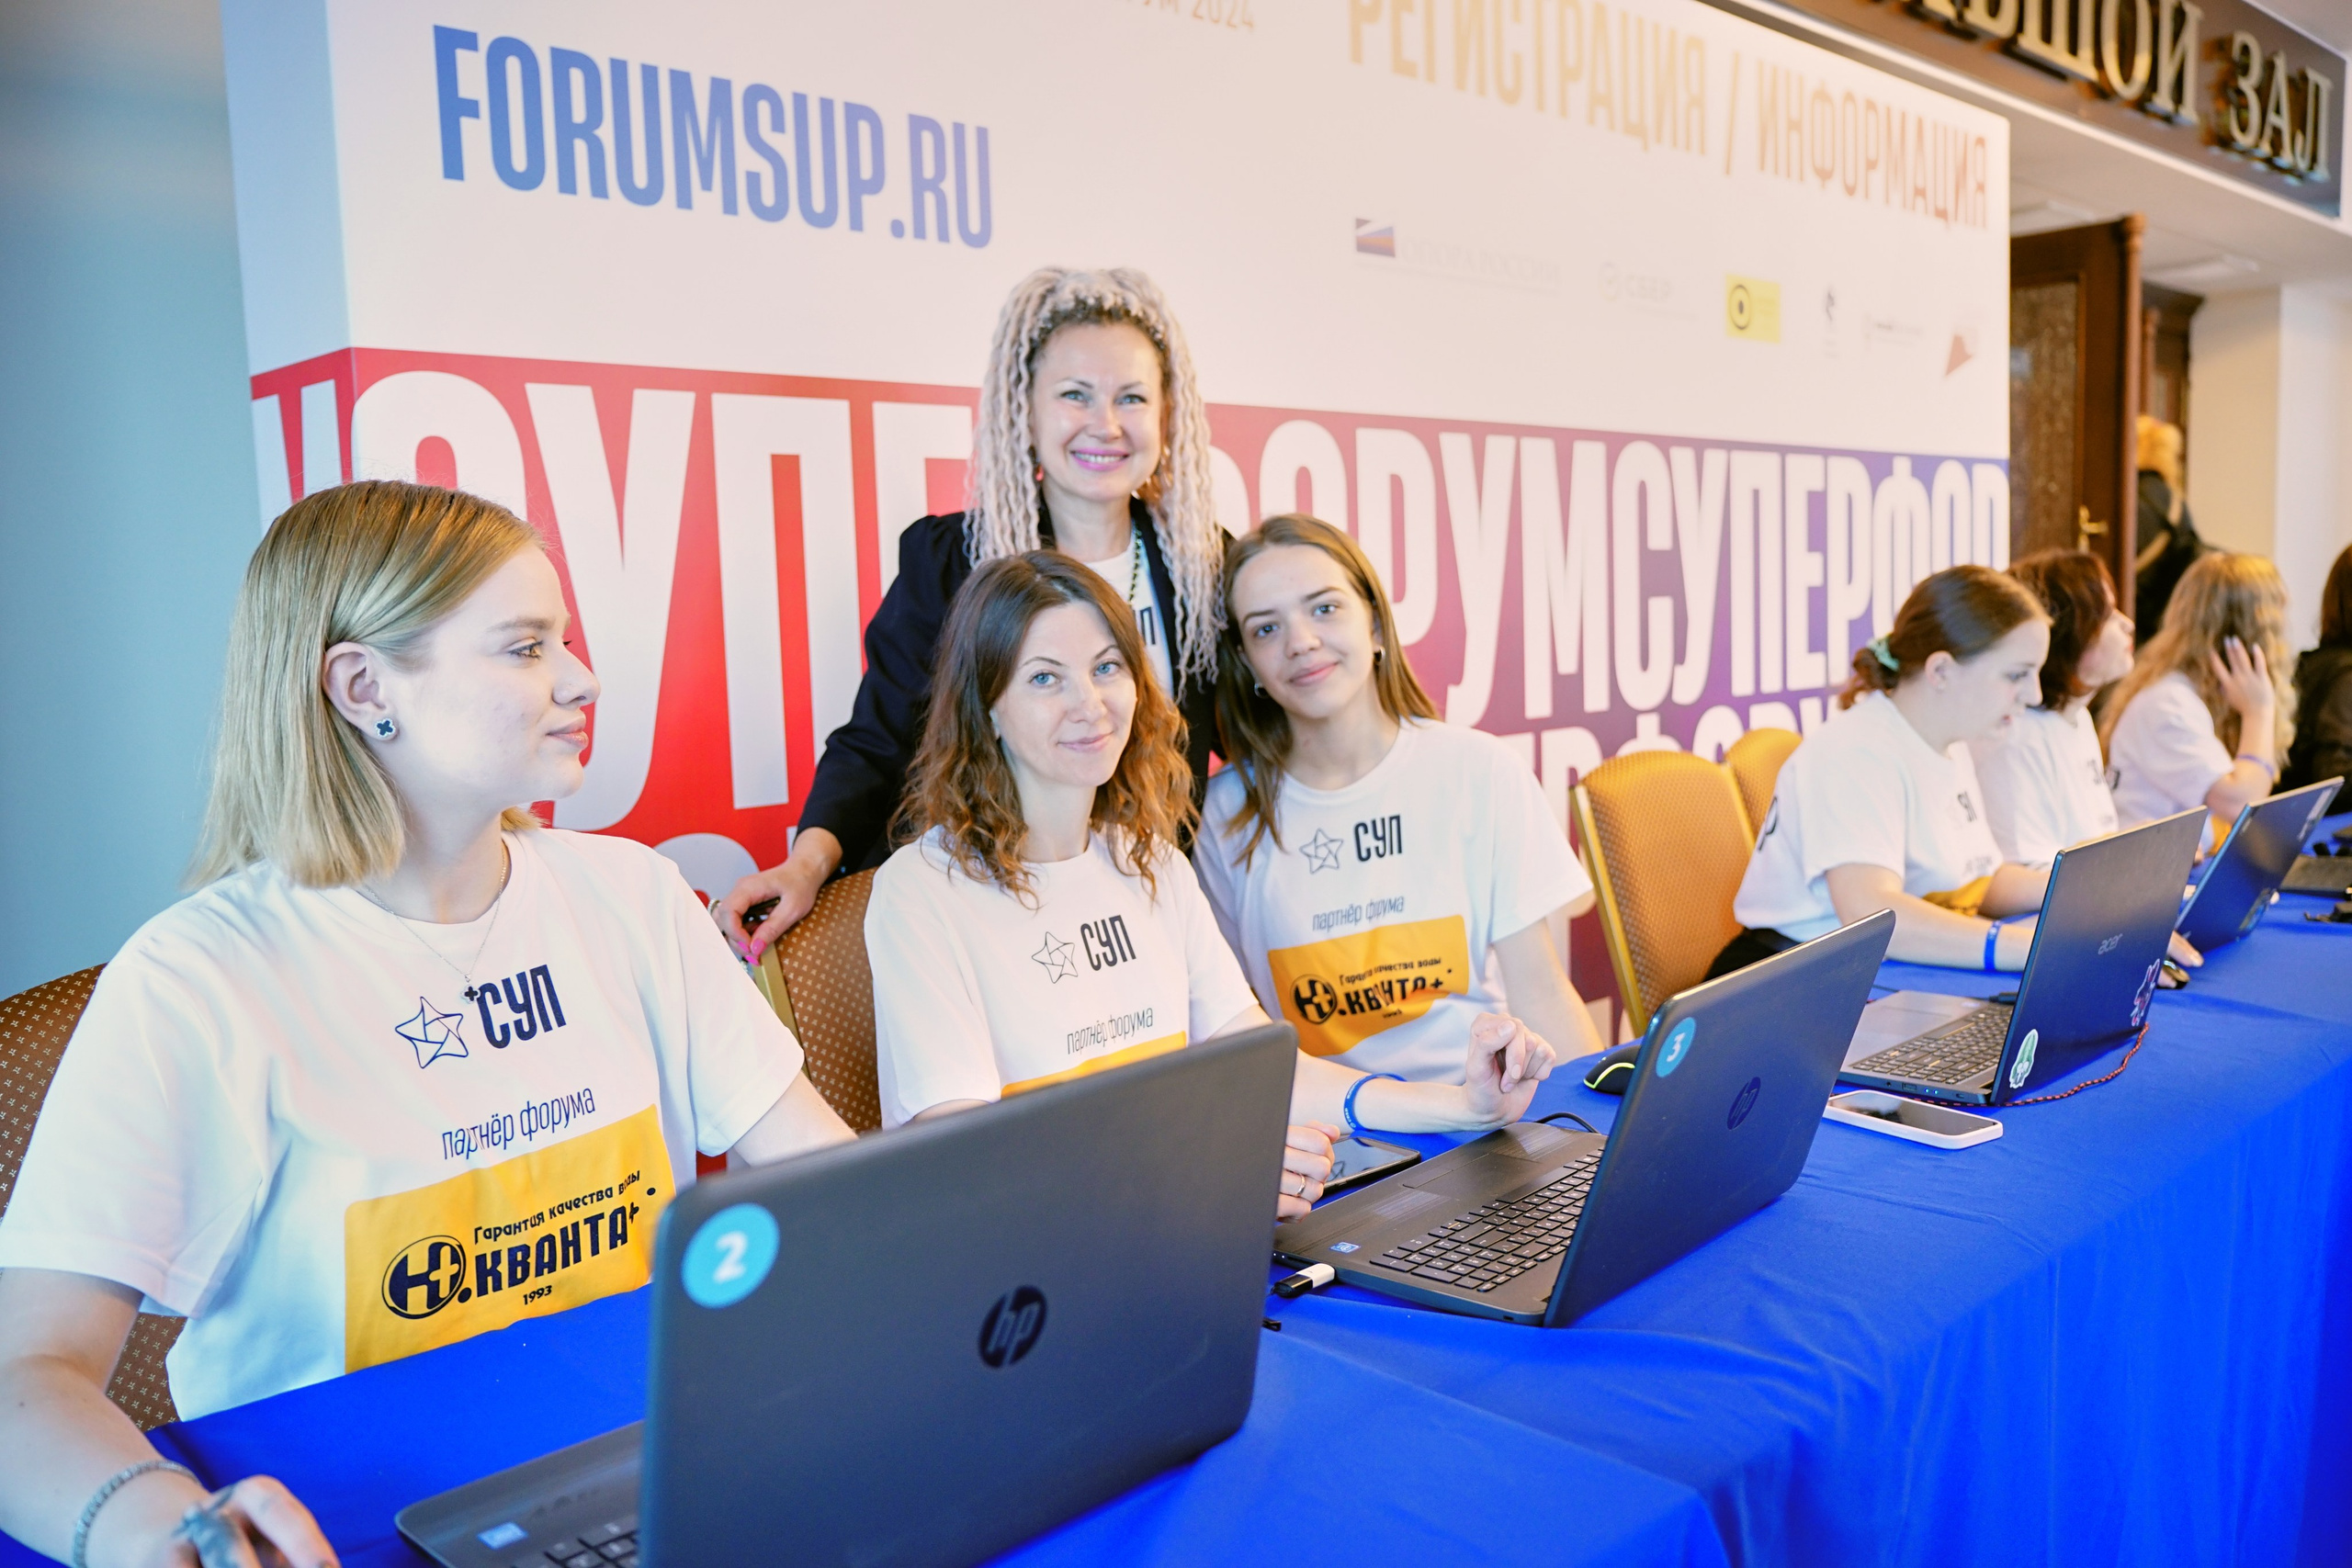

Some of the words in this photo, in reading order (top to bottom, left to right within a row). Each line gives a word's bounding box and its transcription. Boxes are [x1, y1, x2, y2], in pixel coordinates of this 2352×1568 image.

[2230, 30, 2333, 179] ЗАЛ
[434, 25, 993, 248] FORUMSUP.RU
[1757, 57, 1988, 231] ИНФОРМАЦИЯ
[1354, 814, 1403, 862] СУП
[1080, 915, 1136, 971] СУП
[2098, 933, 2123, 955] acer
[477, 964, 567, 1049] СУП
[1068, 1020, 1107, 1055] партнёр
[1108, 1008, 1153, 1044] форума
[1667, 1032, 1687, 1063] 3
[442, 1113, 514, 1160] партнёр
[519, 1088, 596, 1142] форума
[474, 1211, 545, 1245] Гарантия
[548, 1186, 614, 1220] качества
[712, 1230, 749, 1284] 2
[523, 1284, 553, 1305] 1993
